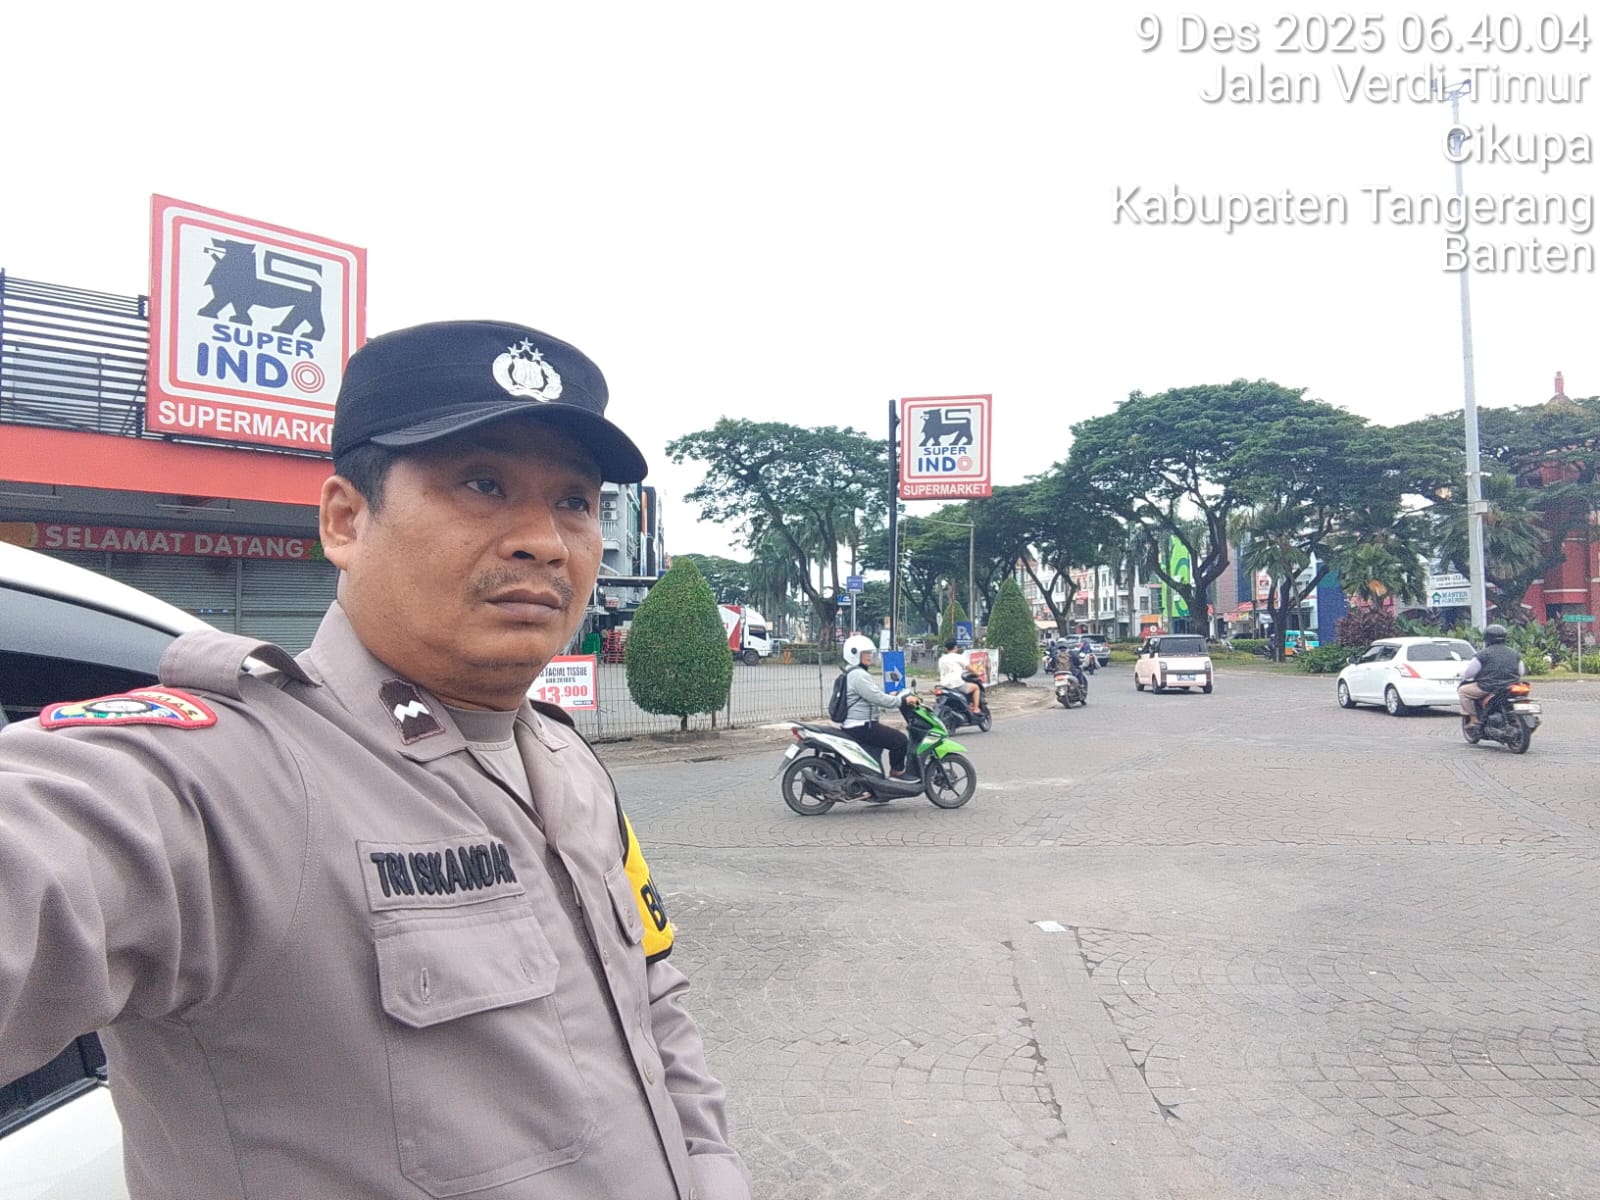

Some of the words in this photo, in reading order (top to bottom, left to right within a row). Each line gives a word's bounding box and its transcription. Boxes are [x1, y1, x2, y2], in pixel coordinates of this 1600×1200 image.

[212, 323, 315, 359] SUPER
[196, 342, 326, 394] INDO
[917, 455, 973, 473] INDO
[923, 447, 967, 456] SUPER
[903, 483, 987, 497] SUPERMARKET
[45, 525, 186, 554] SELAMAT
[194, 533, 305, 559] DATANG
[545, 667, 566, 677] FACIAL
[567, 666, 587, 677] TISSUE
[370, 851, 415, 898] TRI
[408, 841, 518, 896] ISKANDAR
